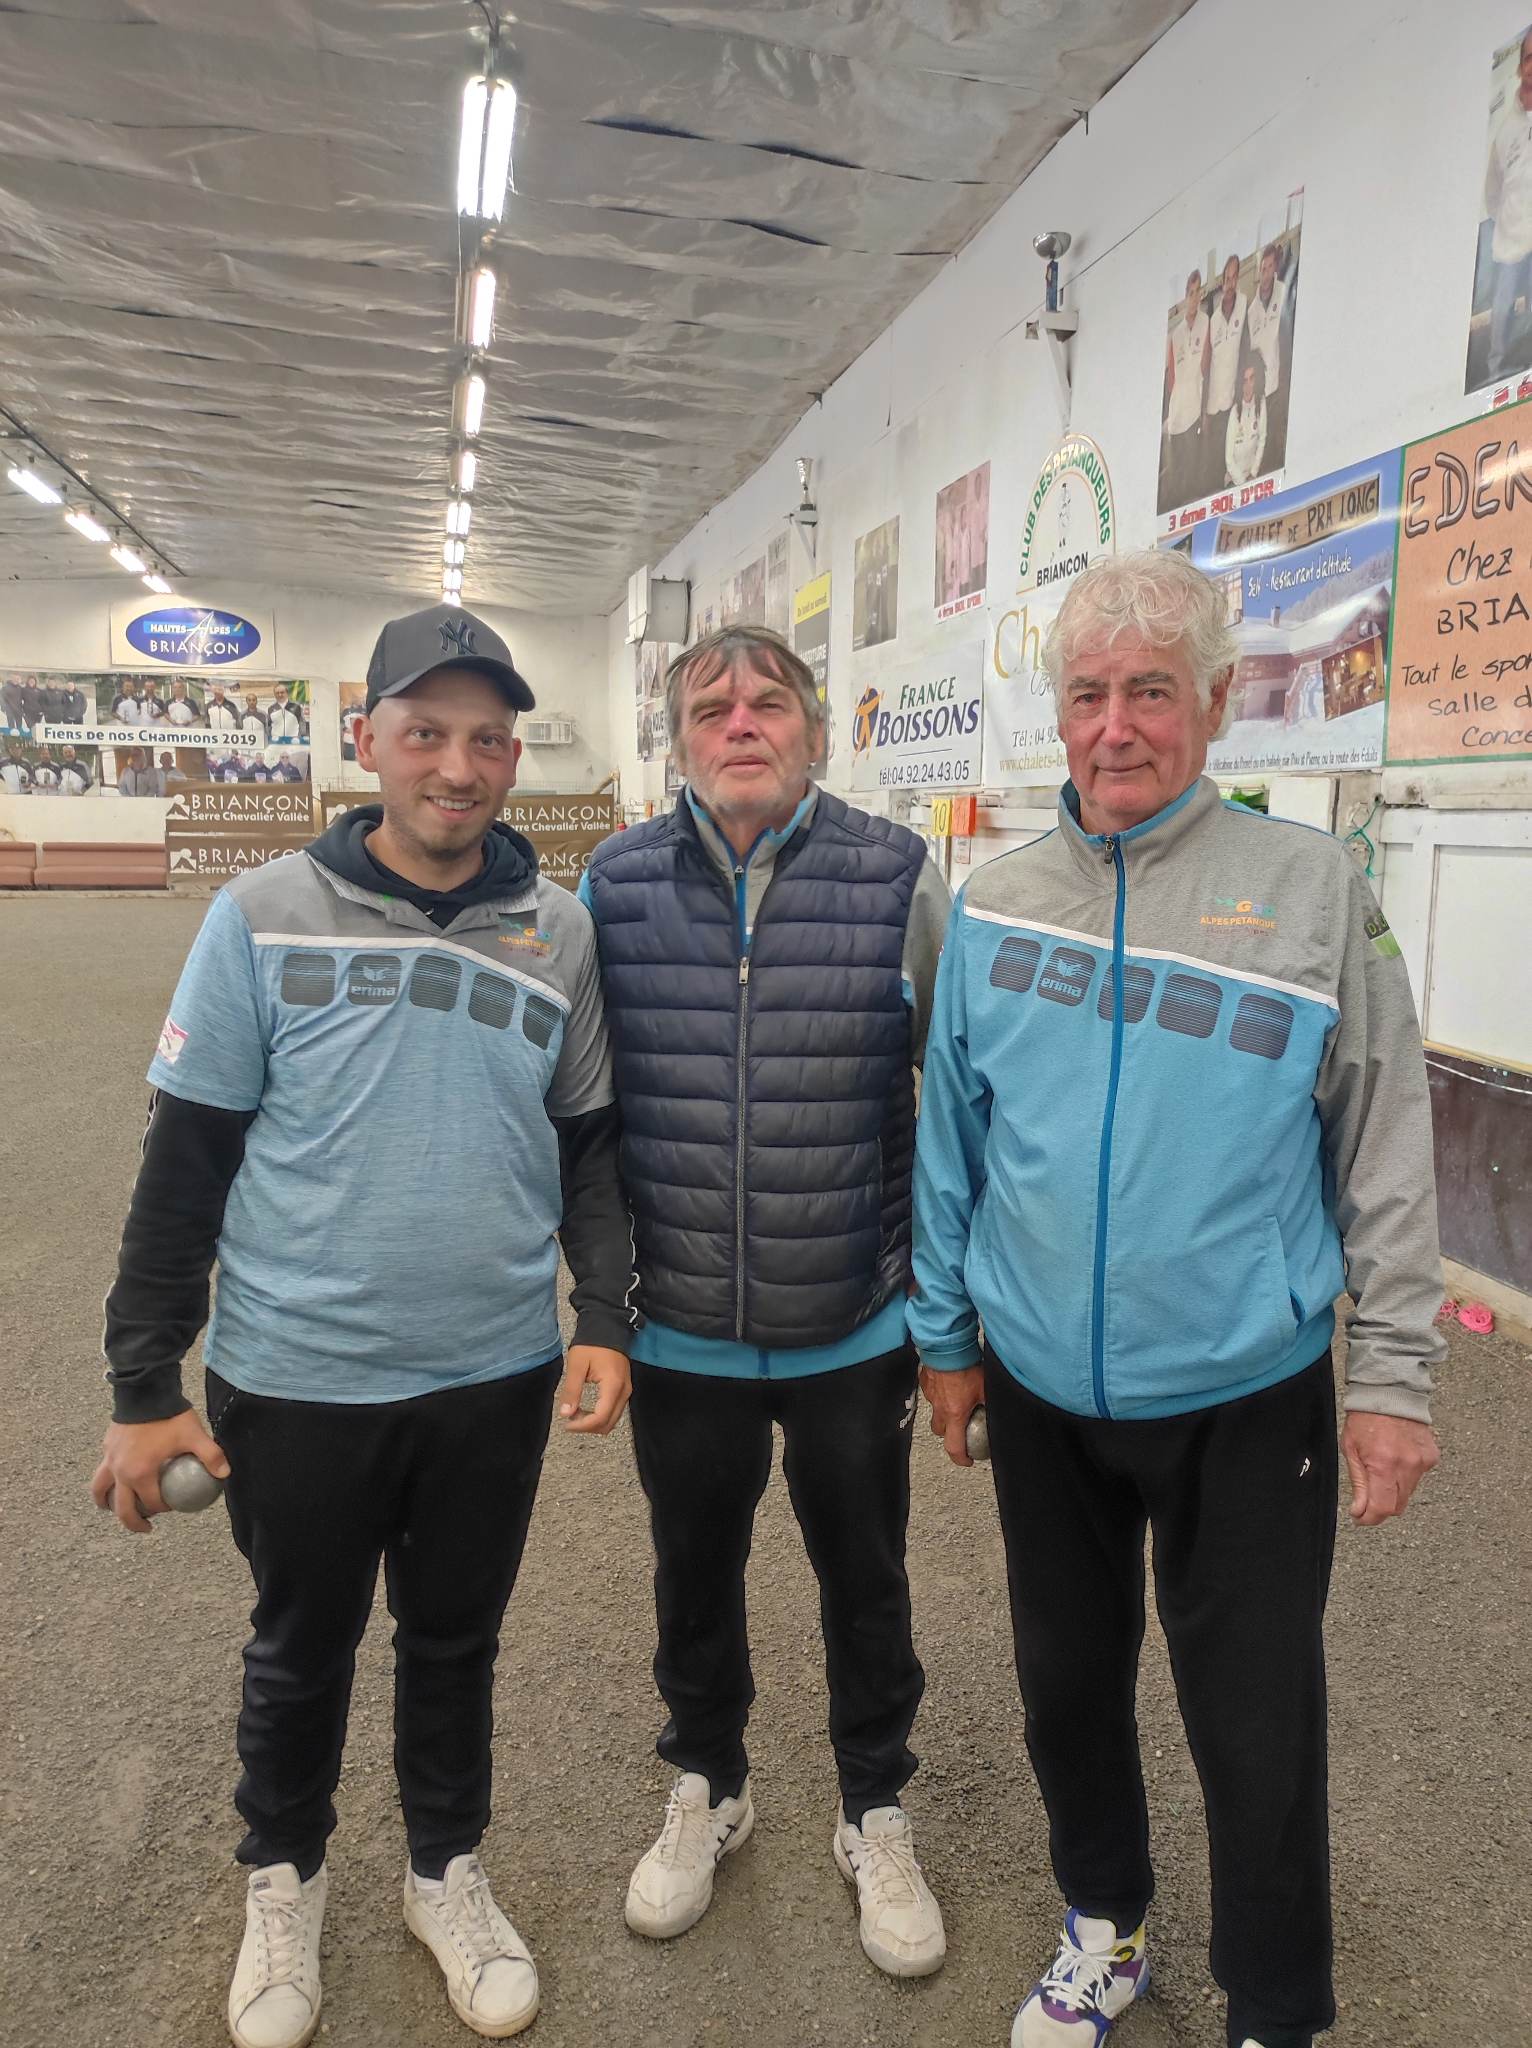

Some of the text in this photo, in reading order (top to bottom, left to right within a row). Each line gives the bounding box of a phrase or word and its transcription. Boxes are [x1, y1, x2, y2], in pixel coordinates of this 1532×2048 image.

[1168, 514, 1177, 532] 3
[1241, 479, 1274, 506] D'OR
[1307, 499, 1333, 537] PRA
[1340, 482, 1376, 520] LONG
[1019, 511, 1036, 577] CLUB
[1447, 540, 1513, 585] Chez
[1270, 562, 1314, 592] Restaurant
[1437, 592, 1531, 635] BRIA
[150, 639, 239, 657] BRIANÇON
[993, 603, 1041, 679] Ch
[1401, 653, 1532, 687] Tout le spor
[899, 676, 957, 710] FRANCE
[1513, 685, 1532, 709] d
[875, 699, 981, 748] BOISSONS
[222, 733, 257, 746] 2019
[1462, 726, 1532, 747] Conce
[191, 793, 310, 814] BRIANÇON
[503, 805, 610, 824] BRIANÇON
[191, 811, 310, 822] Serre Chevalier Vallée
[511, 821, 611, 832] erre Chevalier Vallée
[933, 802, 947, 832] 10
[198, 865, 258, 875] Serre Chev
[539, 868, 580, 878] hevalier
[351, 984, 396, 997] erima
[1040, 977, 1082, 998] erima
